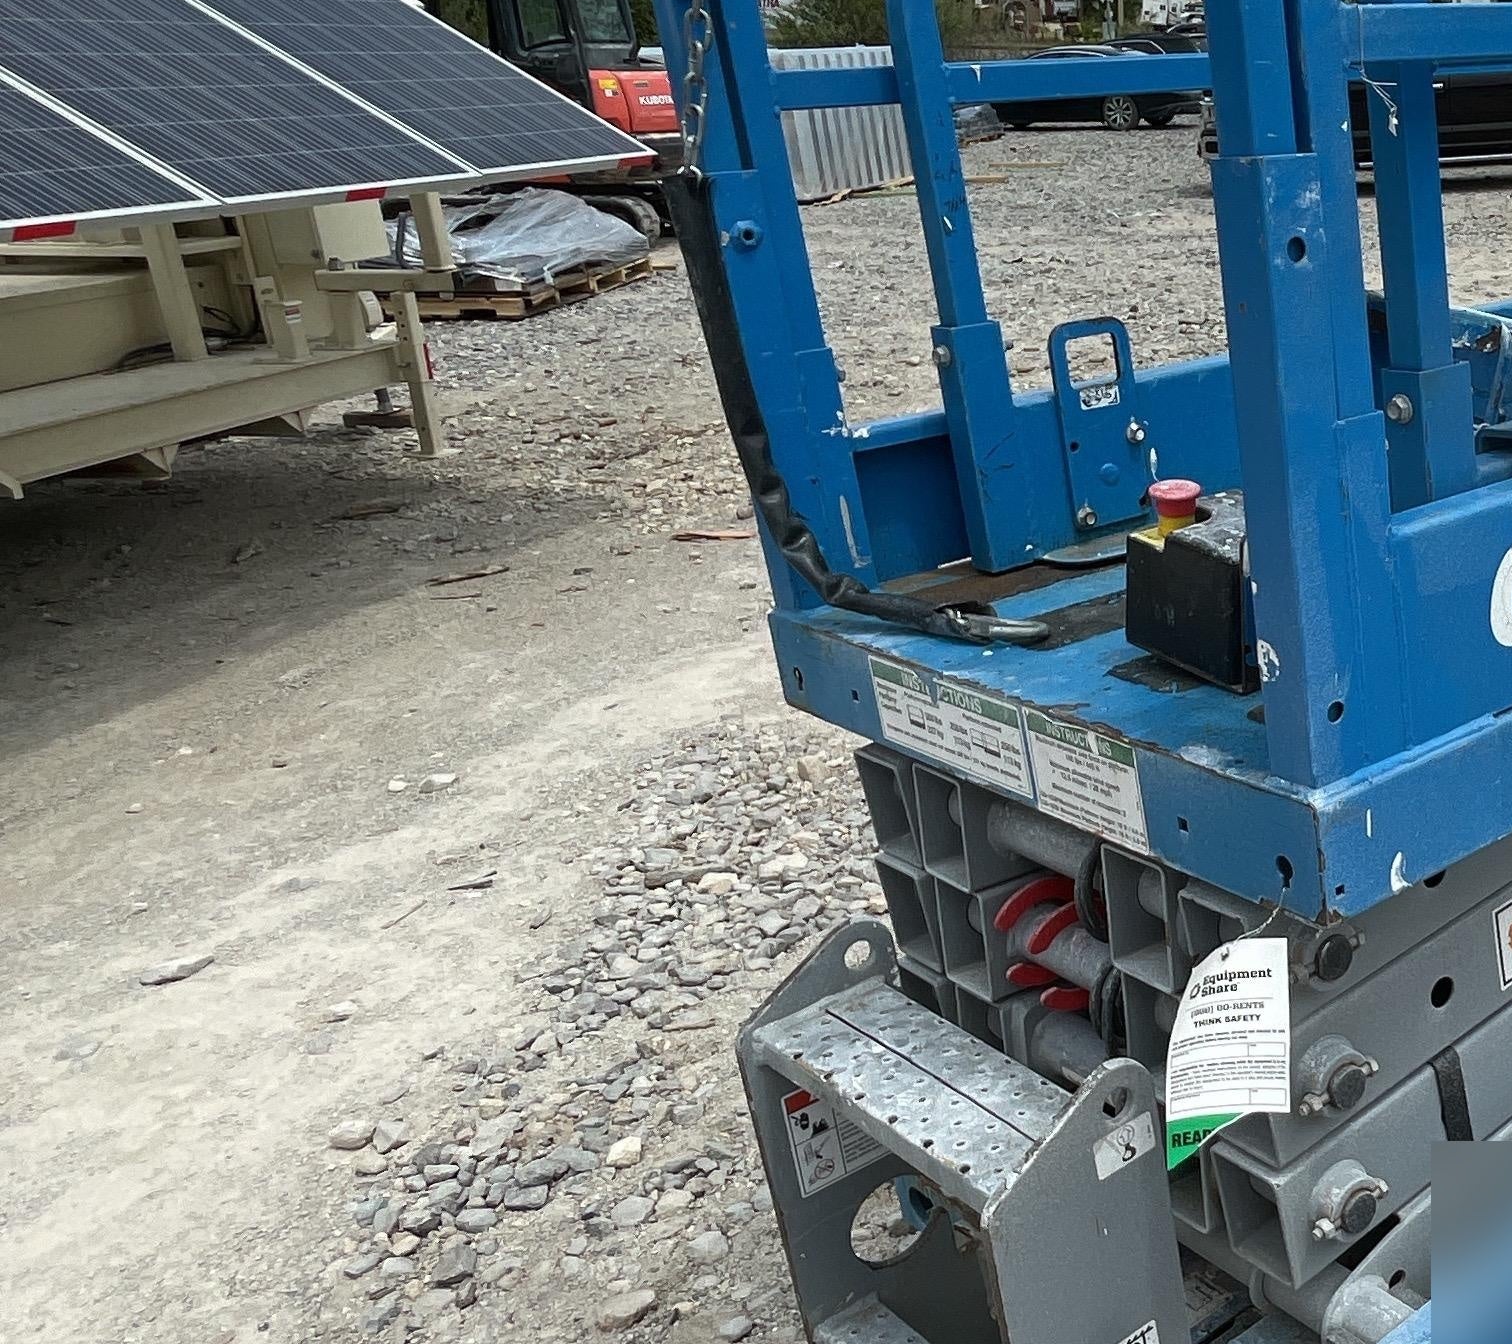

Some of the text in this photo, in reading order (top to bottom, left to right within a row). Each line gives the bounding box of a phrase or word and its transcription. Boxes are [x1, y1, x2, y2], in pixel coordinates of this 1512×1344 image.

[1203, 968, 1272, 986] Equipment
[1201, 983, 1238, 997] Share
[1194, 1014, 1261, 1028] THINK SAFETY
